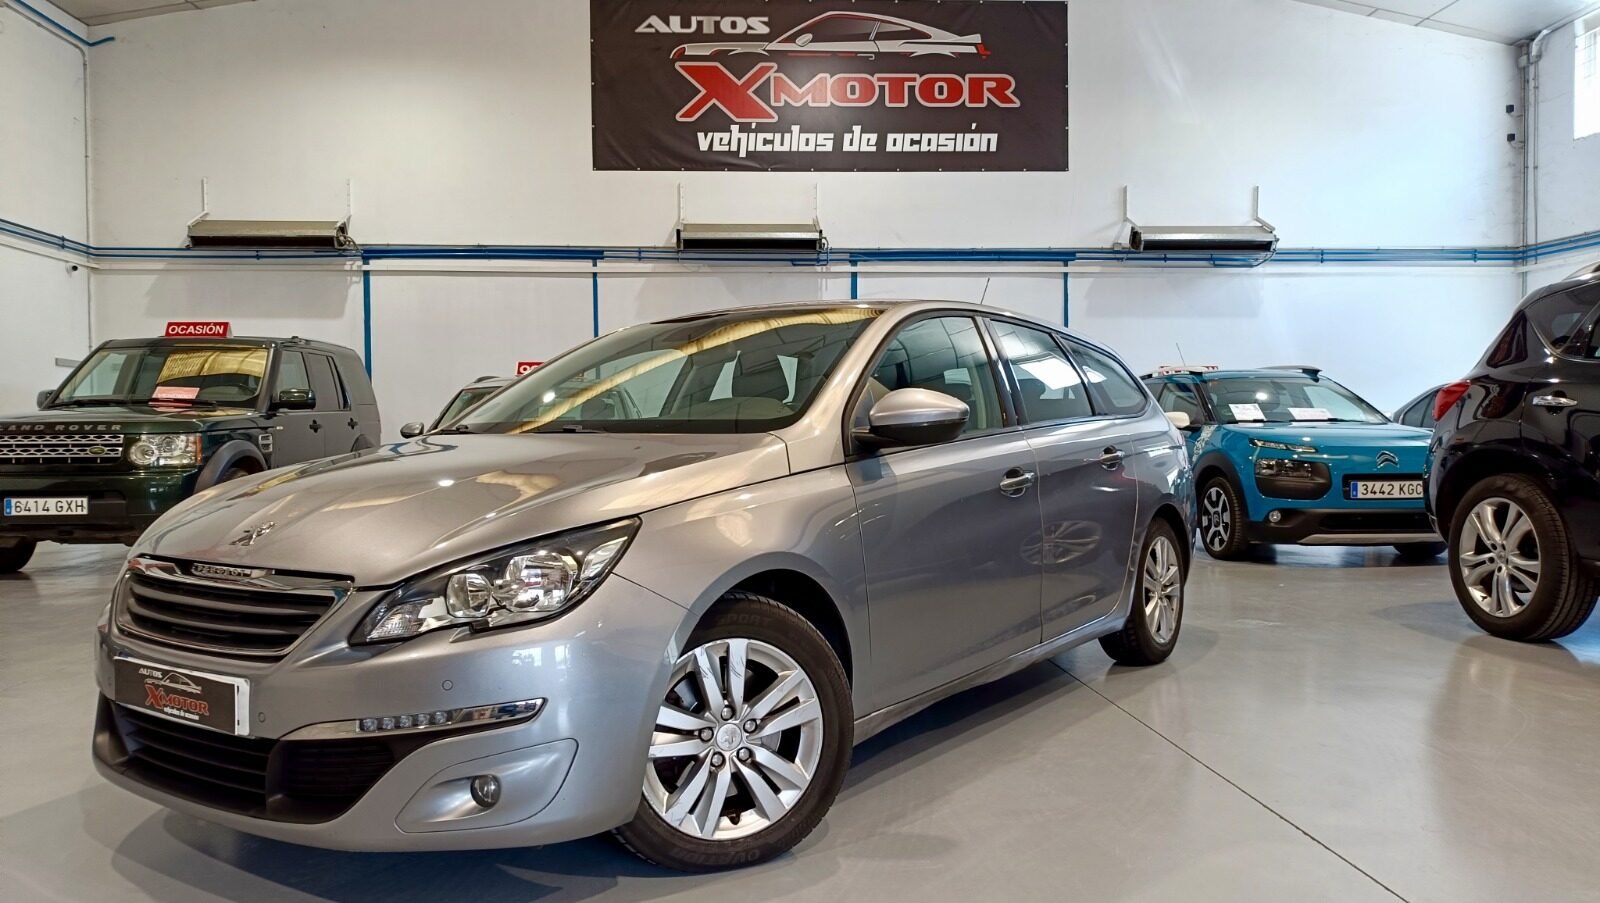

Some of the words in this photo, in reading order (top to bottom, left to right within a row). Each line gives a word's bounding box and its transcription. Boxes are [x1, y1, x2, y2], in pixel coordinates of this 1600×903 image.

[634, 15, 770, 34] AUTOS
[675, 62, 1021, 122] XMOTOR
[697, 123, 834, 157] vehículos
[843, 125, 878, 151] de
[886, 123, 998, 152] ocasión
[168, 323, 224, 335] OCASIÓN
[1361, 483, 1395, 496] 3442
[1399, 483, 1423, 496] KGC
[14, 500, 50, 513] 6414
[55, 499, 84, 513] GXH
[138, 667, 163, 679] AUTOS
[144, 684, 210, 715] XMOTOR
